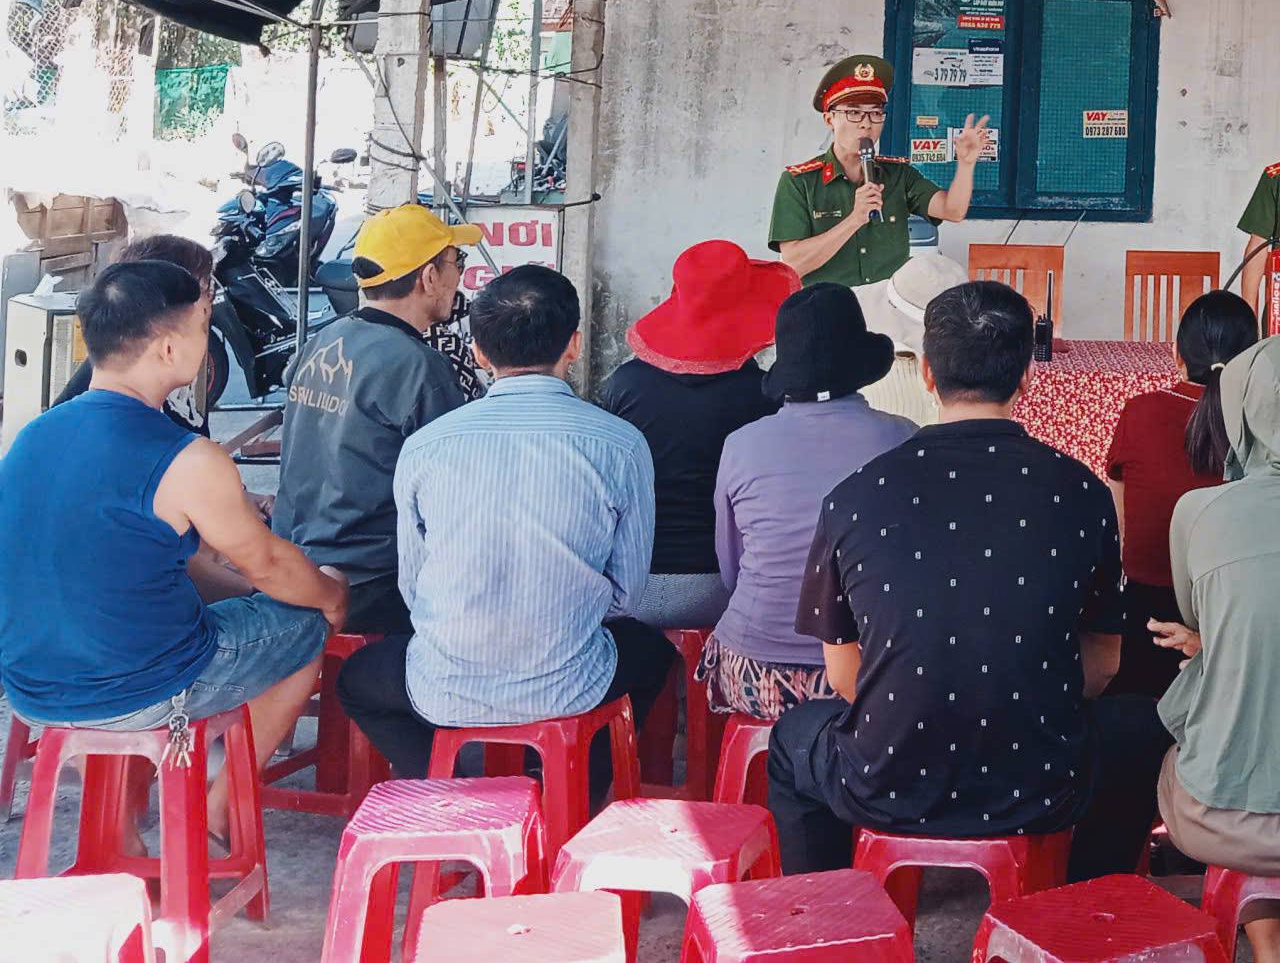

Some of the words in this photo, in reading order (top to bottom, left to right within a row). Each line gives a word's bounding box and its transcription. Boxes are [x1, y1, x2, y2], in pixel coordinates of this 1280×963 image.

[1086, 111, 1108, 121] VAY
[1085, 126, 1101, 136] 0973
[912, 140, 942, 150] VAY
